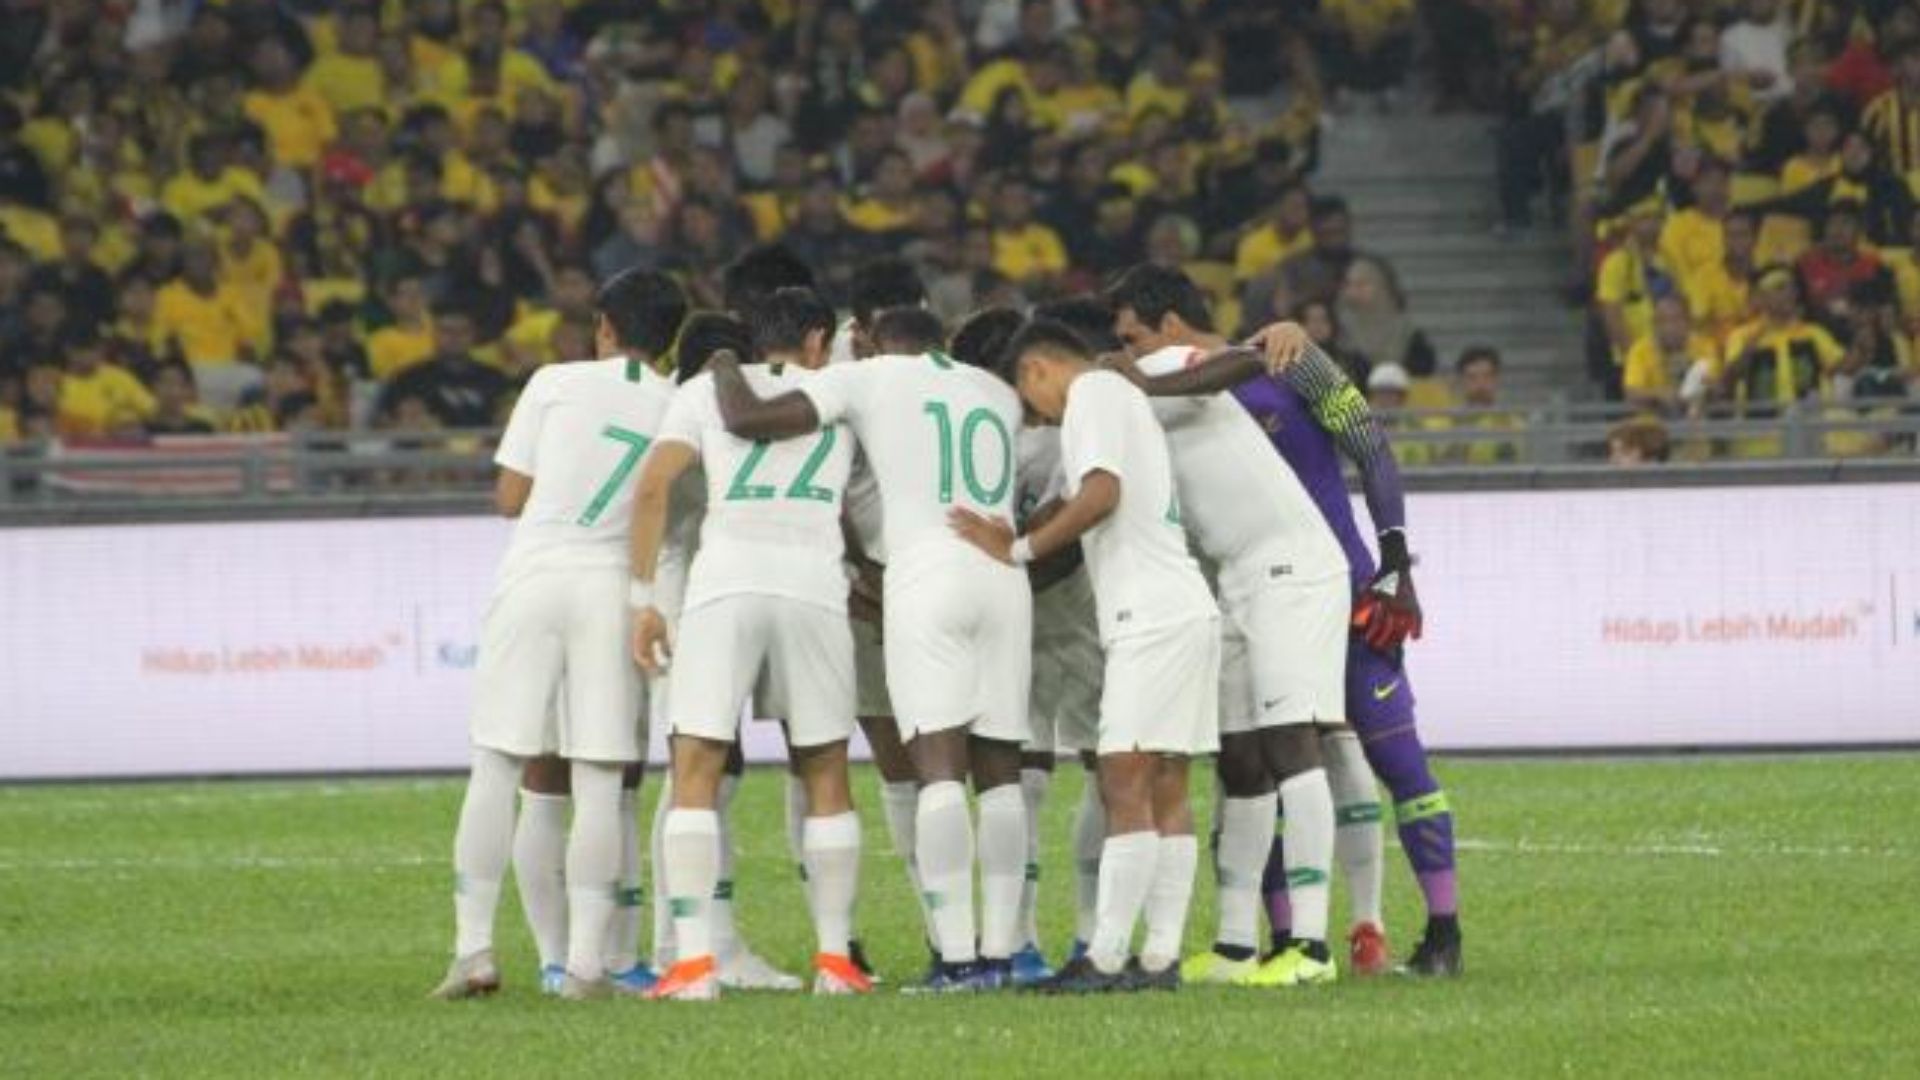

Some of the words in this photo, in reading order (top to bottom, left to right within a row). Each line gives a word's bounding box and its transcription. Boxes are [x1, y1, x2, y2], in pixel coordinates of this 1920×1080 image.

[576, 425, 650, 527] 7
[725, 422, 834, 502] 22
[924, 400, 1012, 506] 10
[142, 647, 215, 674] Hidup
[222, 643, 292, 671] Lebih
[298, 642, 384, 670] Mudah
[1602, 617, 1679, 645] Hidup
[1686, 612, 1763, 640] Lebih
[1768, 610, 1859, 639] Mudah
